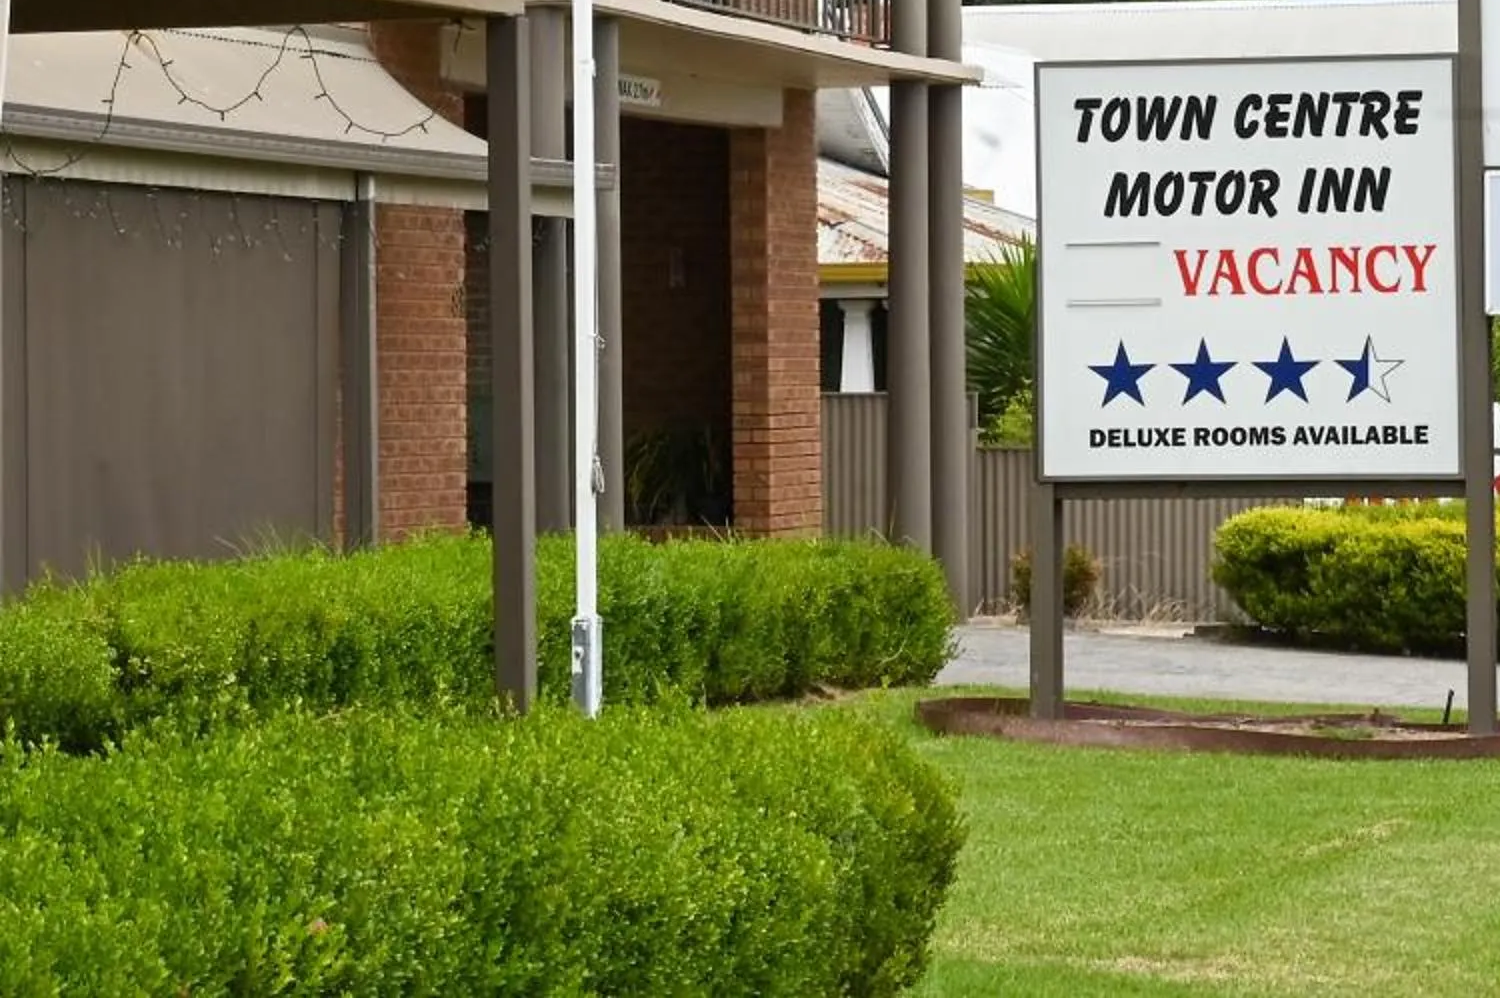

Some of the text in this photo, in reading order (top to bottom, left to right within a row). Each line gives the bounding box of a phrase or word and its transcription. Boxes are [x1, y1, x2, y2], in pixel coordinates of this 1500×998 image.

[1073, 89, 1423, 144] TOWN CENTRE
[1103, 166, 1392, 219] MOTOR INN
[1173, 244, 1437, 296] VACANCY
[1089, 424, 1430, 448] DELUXE ROOMS AVAILABLE
